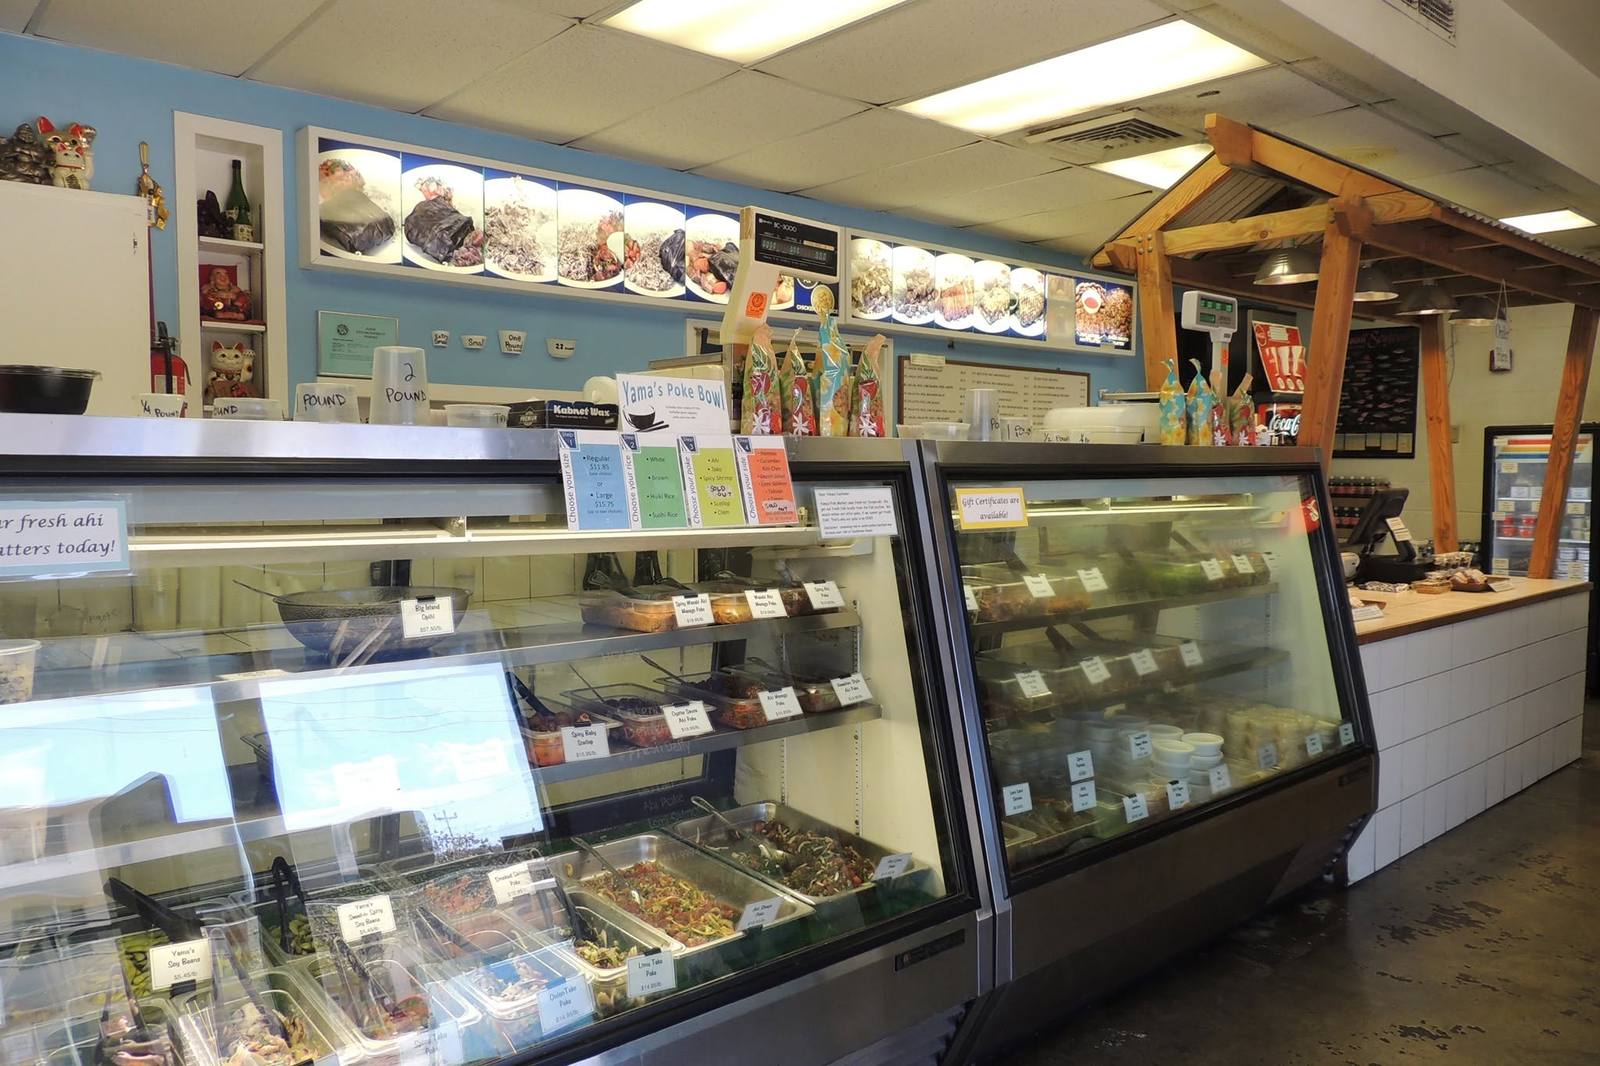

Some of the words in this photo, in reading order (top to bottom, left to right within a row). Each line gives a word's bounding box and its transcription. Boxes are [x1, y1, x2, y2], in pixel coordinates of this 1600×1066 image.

[403, 362, 416, 382] 2
[302, 393, 346, 411] POUND
[385, 387, 427, 403] POUND
[622, 381, 663, 406] Yama's
[667, 382, 694, 398] Poke
[698, 385, 725, 410] Bowl
[553, 405, 590, 416] Kabnet
[590, 407, 611, 417] Wax
[685, 457, 693, 475] poke
[567, 471, 575, 491] your
[628, 471, 636, 491] your
[688, 477, 696, 494] your
[743, 473, 751, 490] your
[596, 492, 613, 500] Large
[747, 491, 757, 519] Choose
[963, 498, 974, 508] Gift
[975, 496, 1008, 507] Certificates
[569, 493, 577, 523] Choose
[631, 492, 640, 522] Choose
[690, 496, 700, 523] Choose
[980, 511, 1008, 520] available!
[16, 513, 67, 534] fresh
[73, 512, 104, 527] ahi
[58, 539, 115, 557] today!
[171, 948, 195, 956] Yama's
[646, 969, 656, 977] Poke
[559, 999, 572, 1007] Poke
